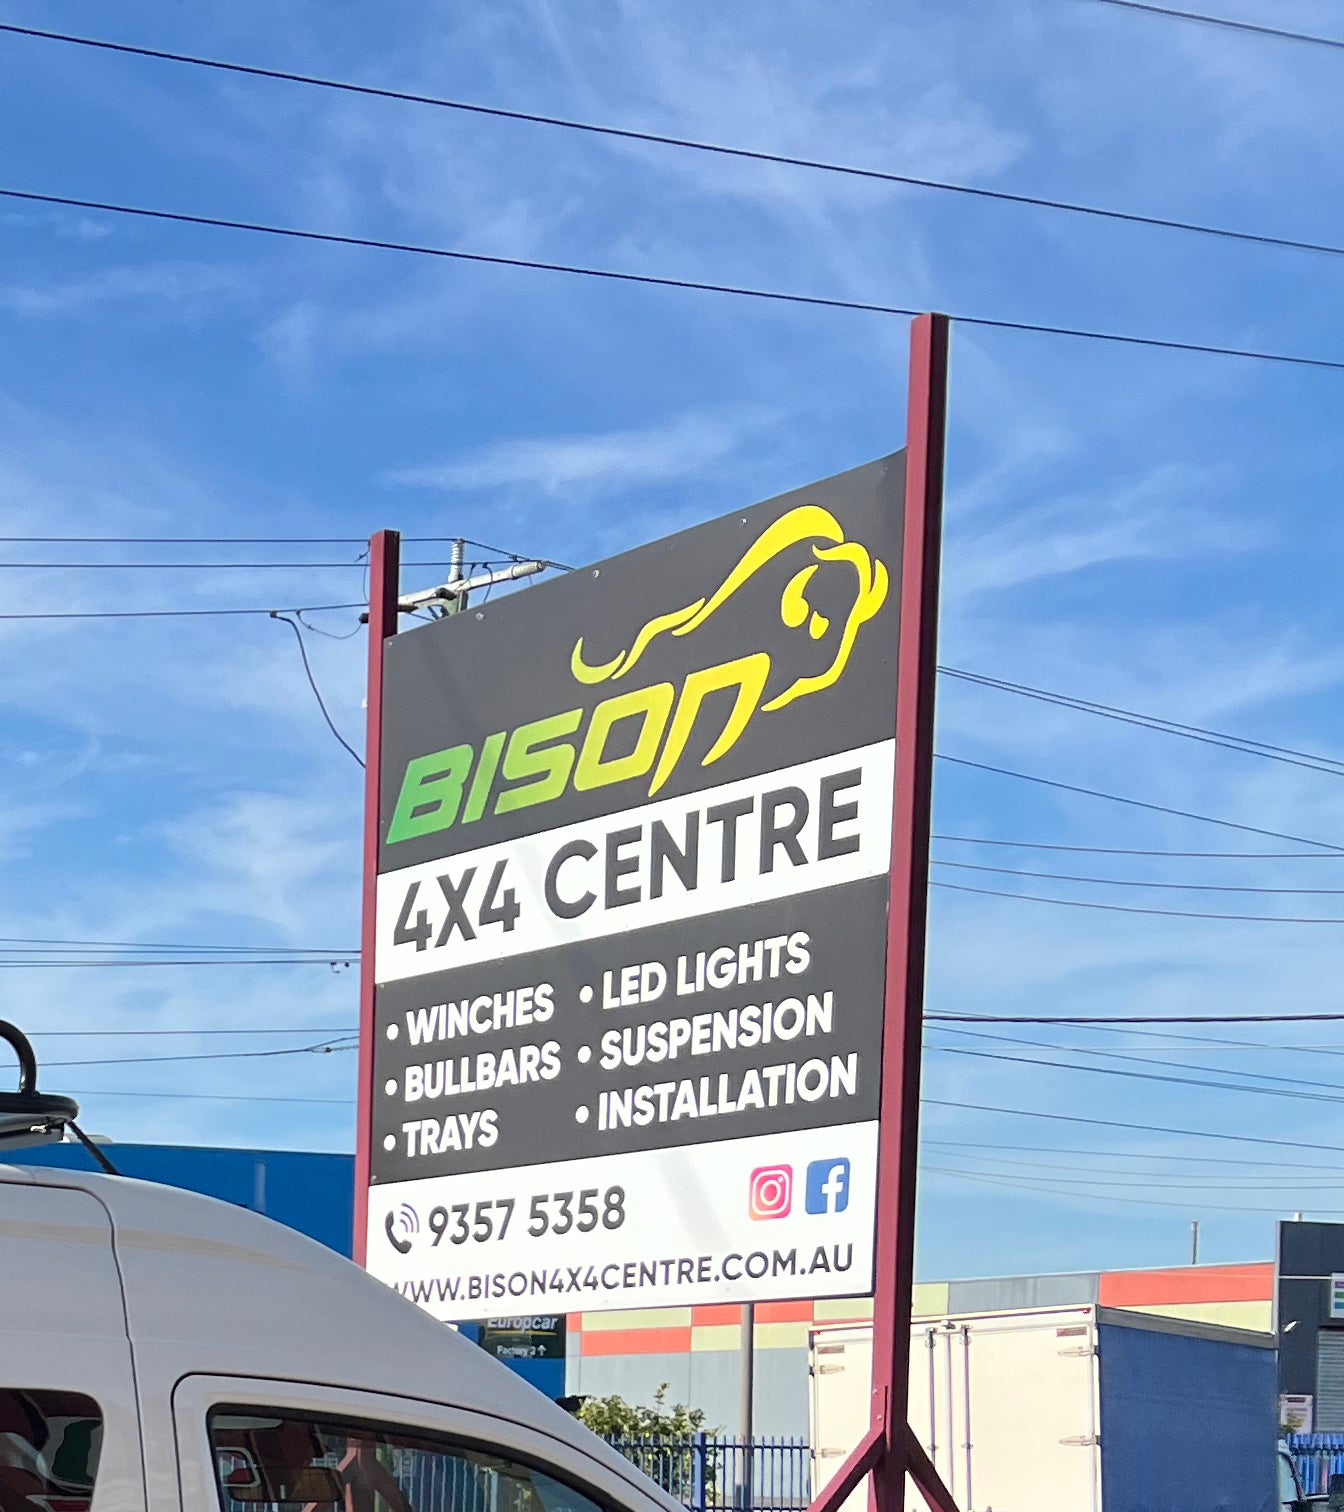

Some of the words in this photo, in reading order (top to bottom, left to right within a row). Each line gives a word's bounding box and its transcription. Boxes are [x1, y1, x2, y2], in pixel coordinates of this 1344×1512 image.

[392, 859, 521, 952] 4X4
[544, 766, 862, 920] CENTRE
[602, 961, 667, 1011] LED
[676, 930, 811, 997] LIGHTS
[406, 982, 555, 1046] WINCHES
[599, 991, 834, 1070] SUSPENSION
[404, 1039, 561, 1103] BULLBARS
[598, 1052, 858, 1132] INSTALLATION
[403, 1108, 499, 1158] TRAYS
[429, 1198, 515, 1247] 9357
[526, 1184, 626, 1238] 5358
[487, 1316, 558, 1334] Europcar
